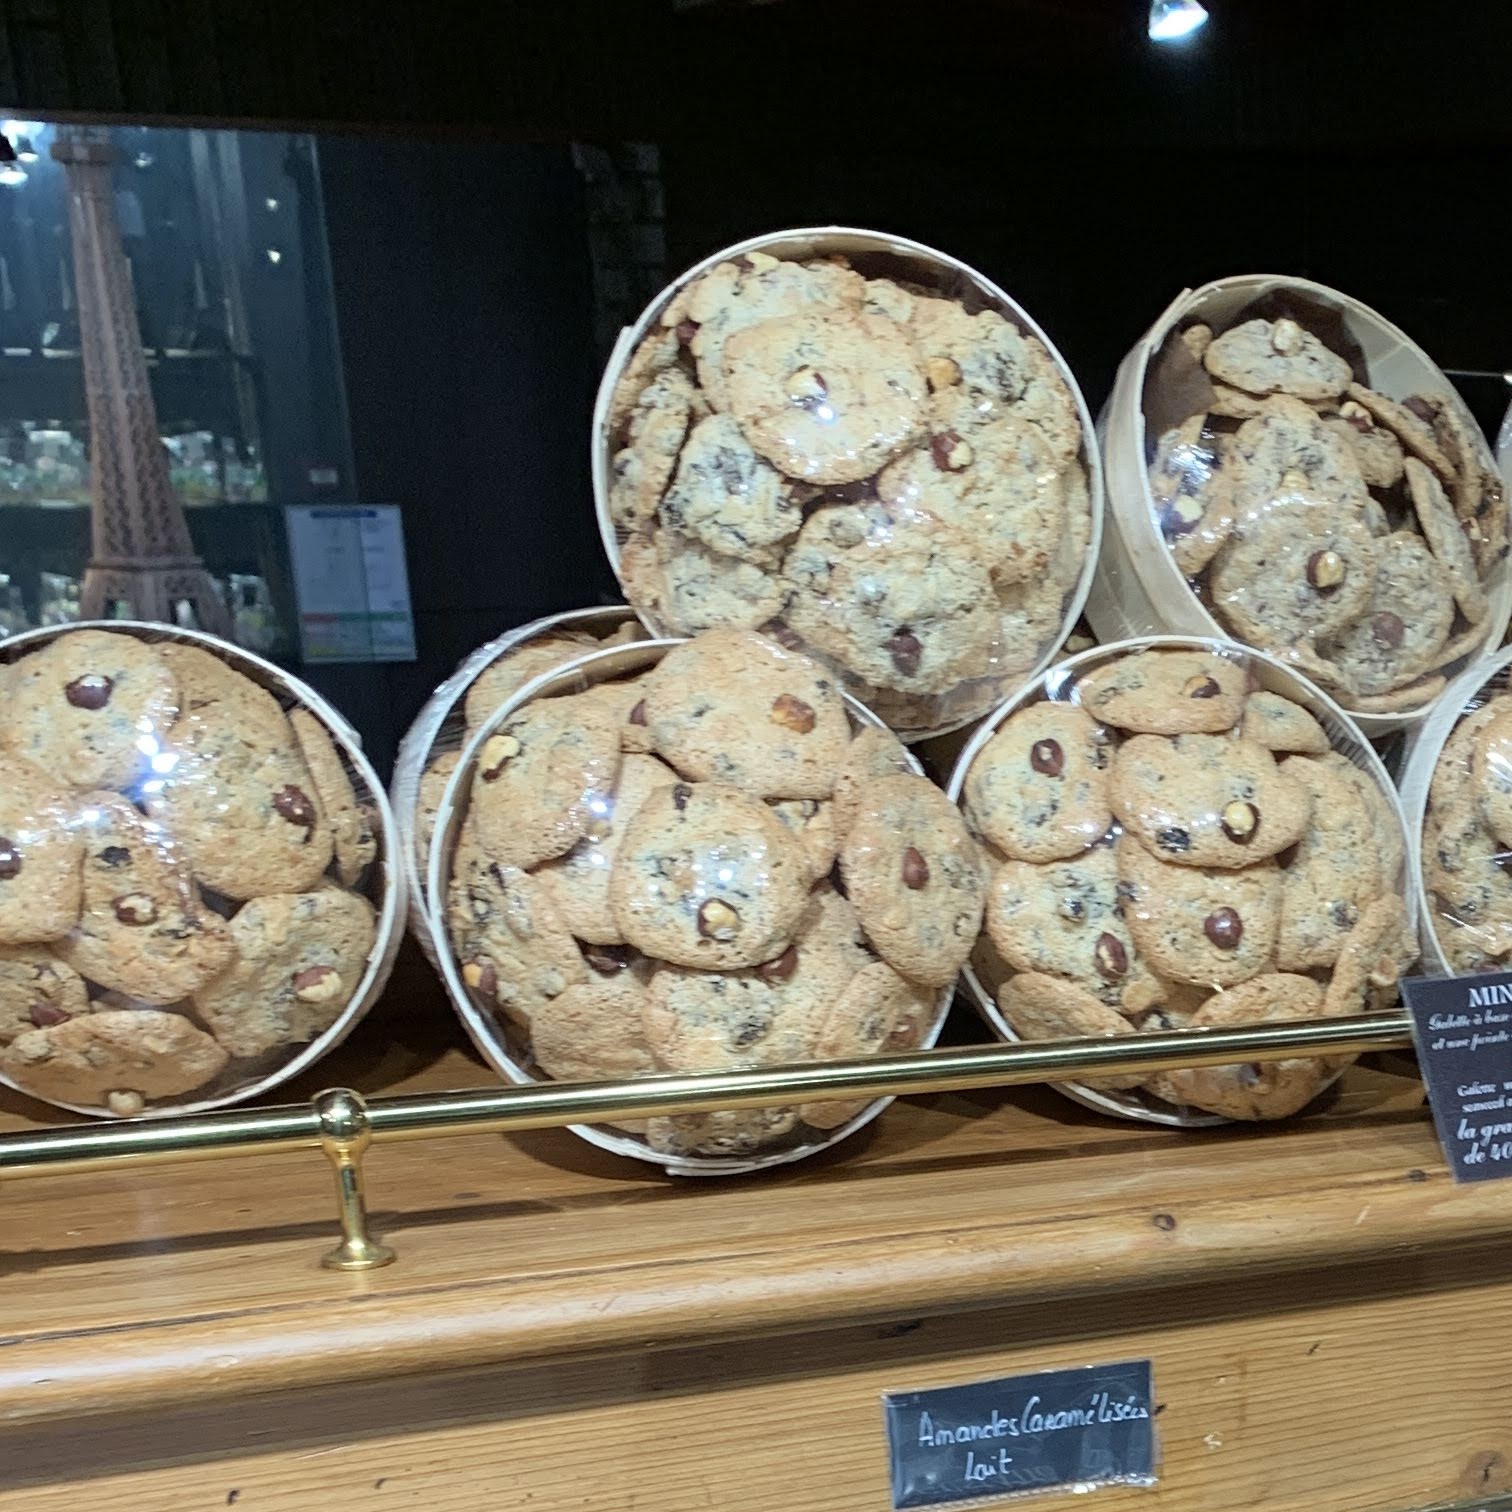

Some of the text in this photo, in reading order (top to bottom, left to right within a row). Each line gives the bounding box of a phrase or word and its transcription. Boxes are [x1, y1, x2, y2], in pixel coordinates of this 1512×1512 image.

[1457, 1118, 1478, 1140] la
[1463, 1142, 1488, 1165] de
[917, 1409, 1019, 1447] Amandes
